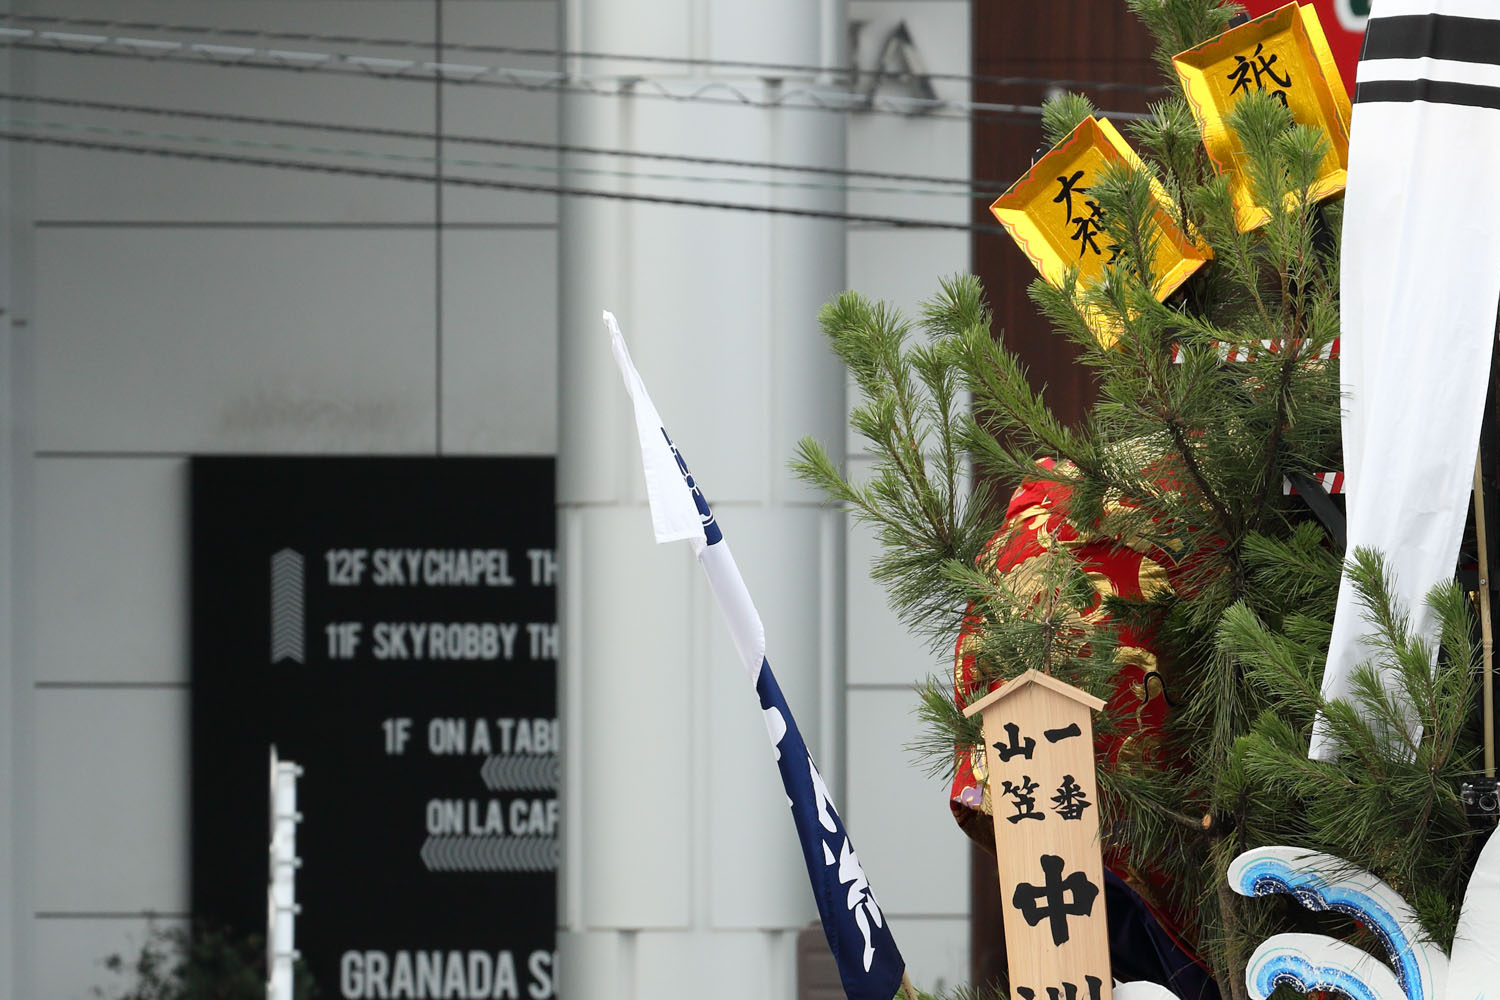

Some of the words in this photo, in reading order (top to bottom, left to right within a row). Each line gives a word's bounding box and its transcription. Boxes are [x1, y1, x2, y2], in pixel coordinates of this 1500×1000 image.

[325, 549, 367, 586] 12F
[372, 549, 515, 586] SKYCHAPEL
[325, 621, 363, 660] 11F
[372, 621, 518, 660] SKYROBBY
[382, 717, 413, 755] 1F
[428, 717, 467, 755] ON
[471, 717, 492, 755] A
[992, 721, 1046, 825] 山笠
[1043, 721, 1093, 822] 一番
[426, 798, 465, 835] ON
[468, 798, 504, 835] LA
[340, 950, 519, 1000] GRANADA
[528, 950, 559, 1000] S
